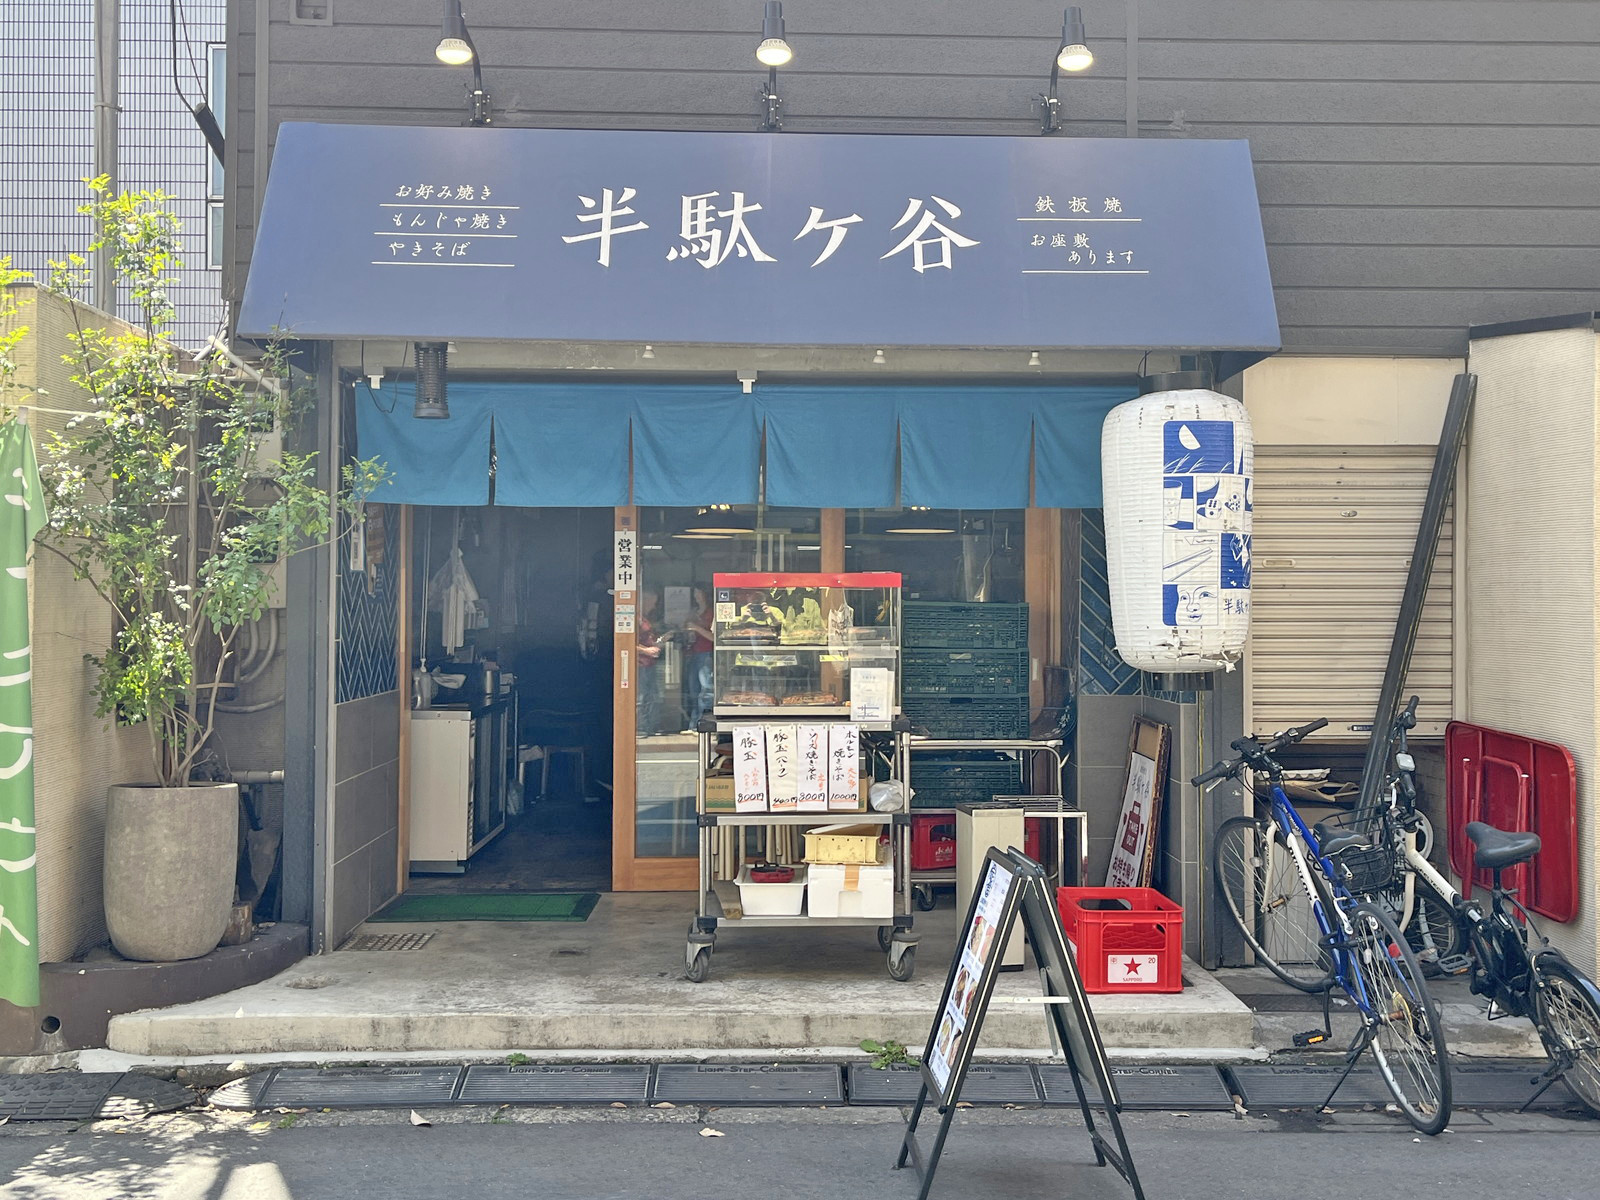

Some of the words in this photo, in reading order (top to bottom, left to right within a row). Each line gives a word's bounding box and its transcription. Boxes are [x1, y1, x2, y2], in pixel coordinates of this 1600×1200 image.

[395, 184, 492, 200] お好み焼き
[1035, 195, 1123, 213] 鉄板焼
[392, 212, 508, 230] もんじゃ焼き
[561, 186, 981, 275] 半駄ケ谷
[388, 241, 471, 257] やきそば
[1030, 233, 1090, 248] お座敷
[1068, 249, 1134, 265] あります
[617, 538, 633, 585] 営業中
[740, 735, 758, 762] 豚玉
[846, 730, 857, 759] ホルモン
[805, 732, 818, 781] ソース焼きそば
[832, 747, 846, 781] 焼きそば
[738, 793, 764, 803] 800円
[799, 792, 826, 803] 800円
[830, 793, 857, 802] 1000円
